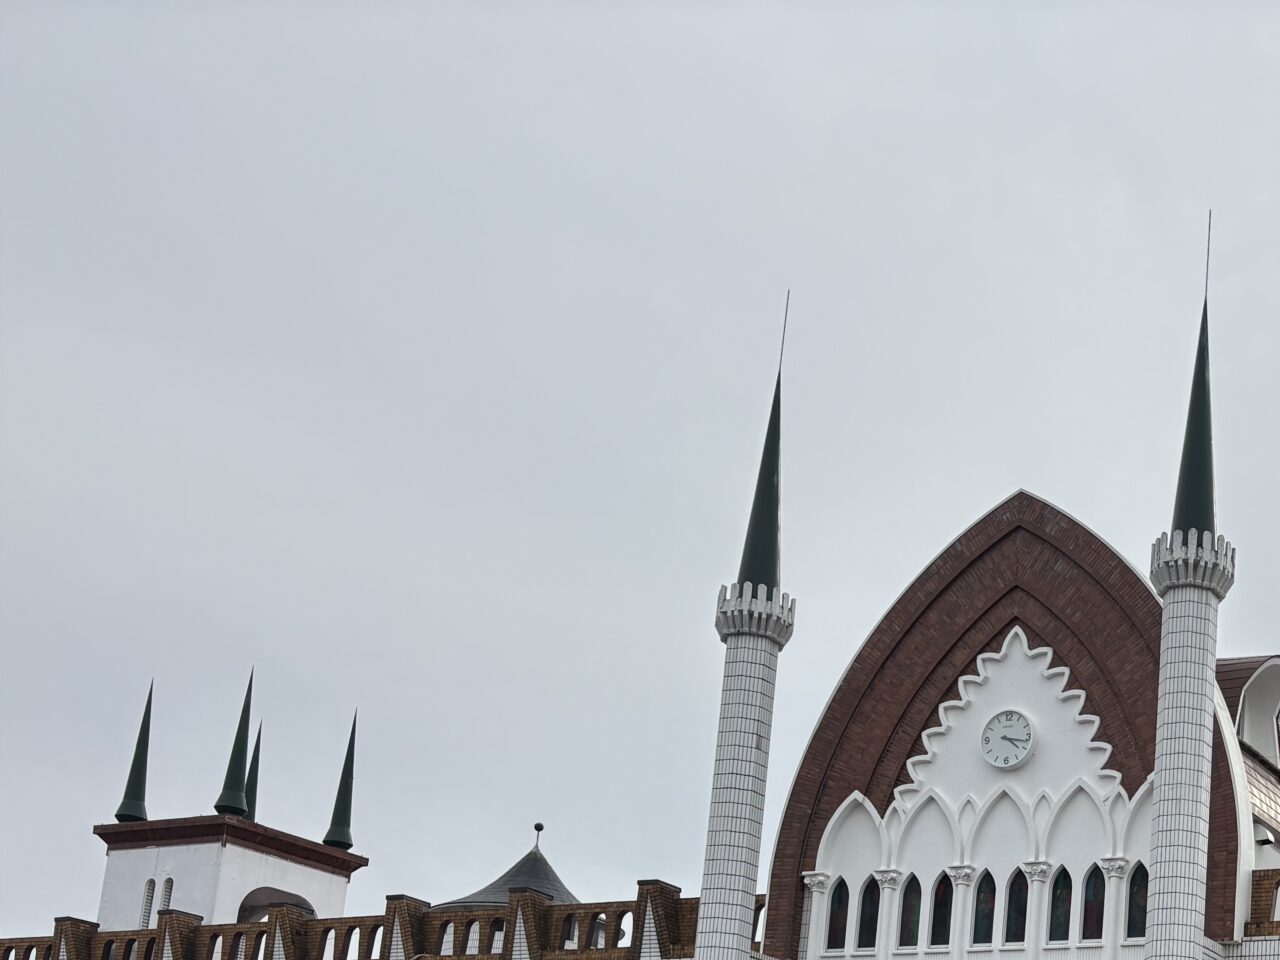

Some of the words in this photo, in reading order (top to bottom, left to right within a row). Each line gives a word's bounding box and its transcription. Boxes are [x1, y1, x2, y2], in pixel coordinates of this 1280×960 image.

[1005, 713, 1014, 721] 12
[984, 736, 990, 745] 9
[1025, 732, 1031, 741] 3
[1003, 756, 1009, 765] 6
